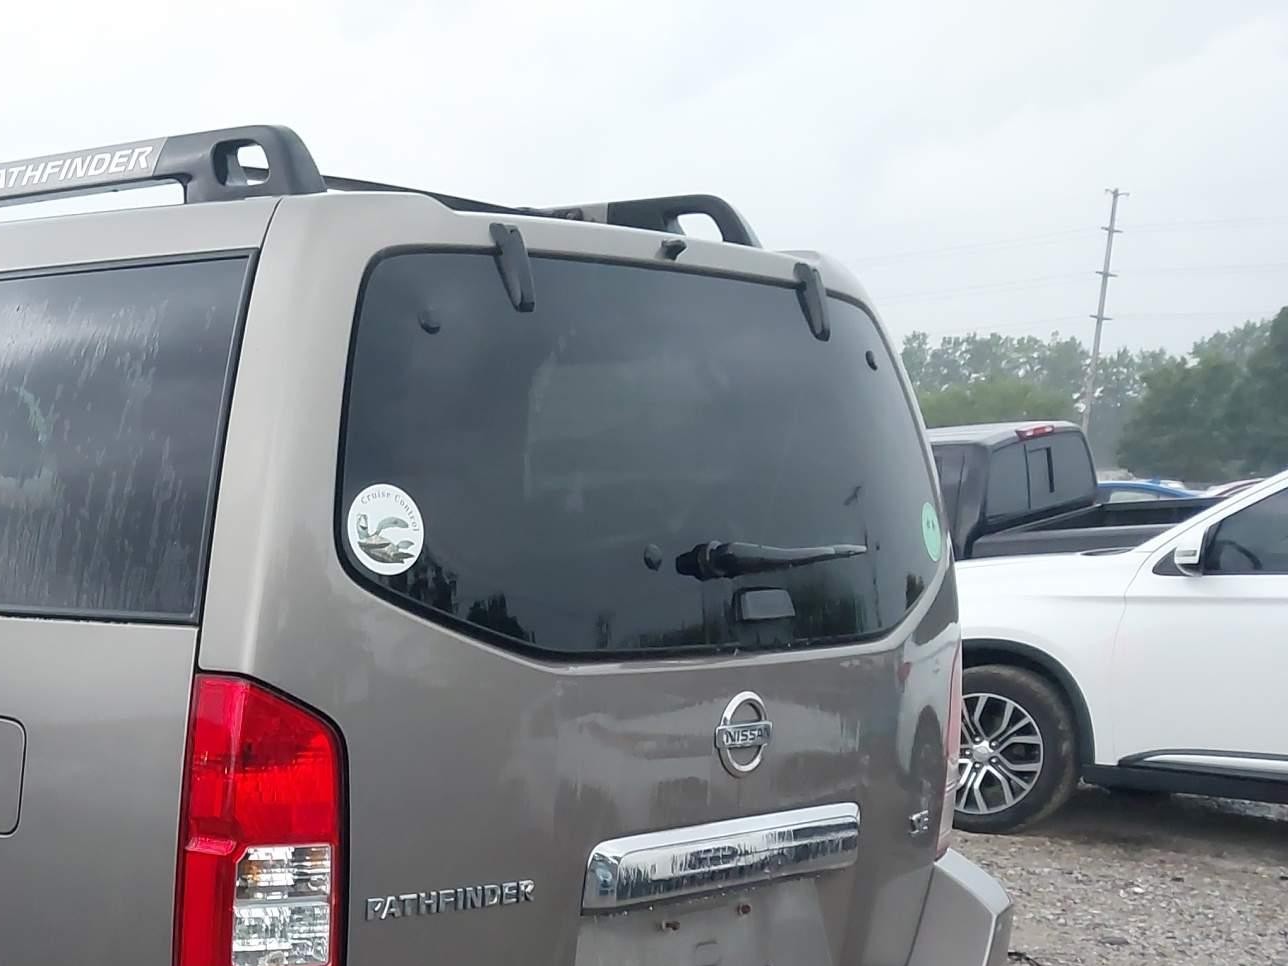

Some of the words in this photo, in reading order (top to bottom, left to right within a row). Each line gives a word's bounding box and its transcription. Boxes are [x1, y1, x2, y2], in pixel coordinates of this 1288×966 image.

[360, 490, 391, 505] Cruise
[394, 494, 420, 532] Control
[725, 728, 770, 743] NISSAN
[366, 879, 535, 920] PATHFINDER
